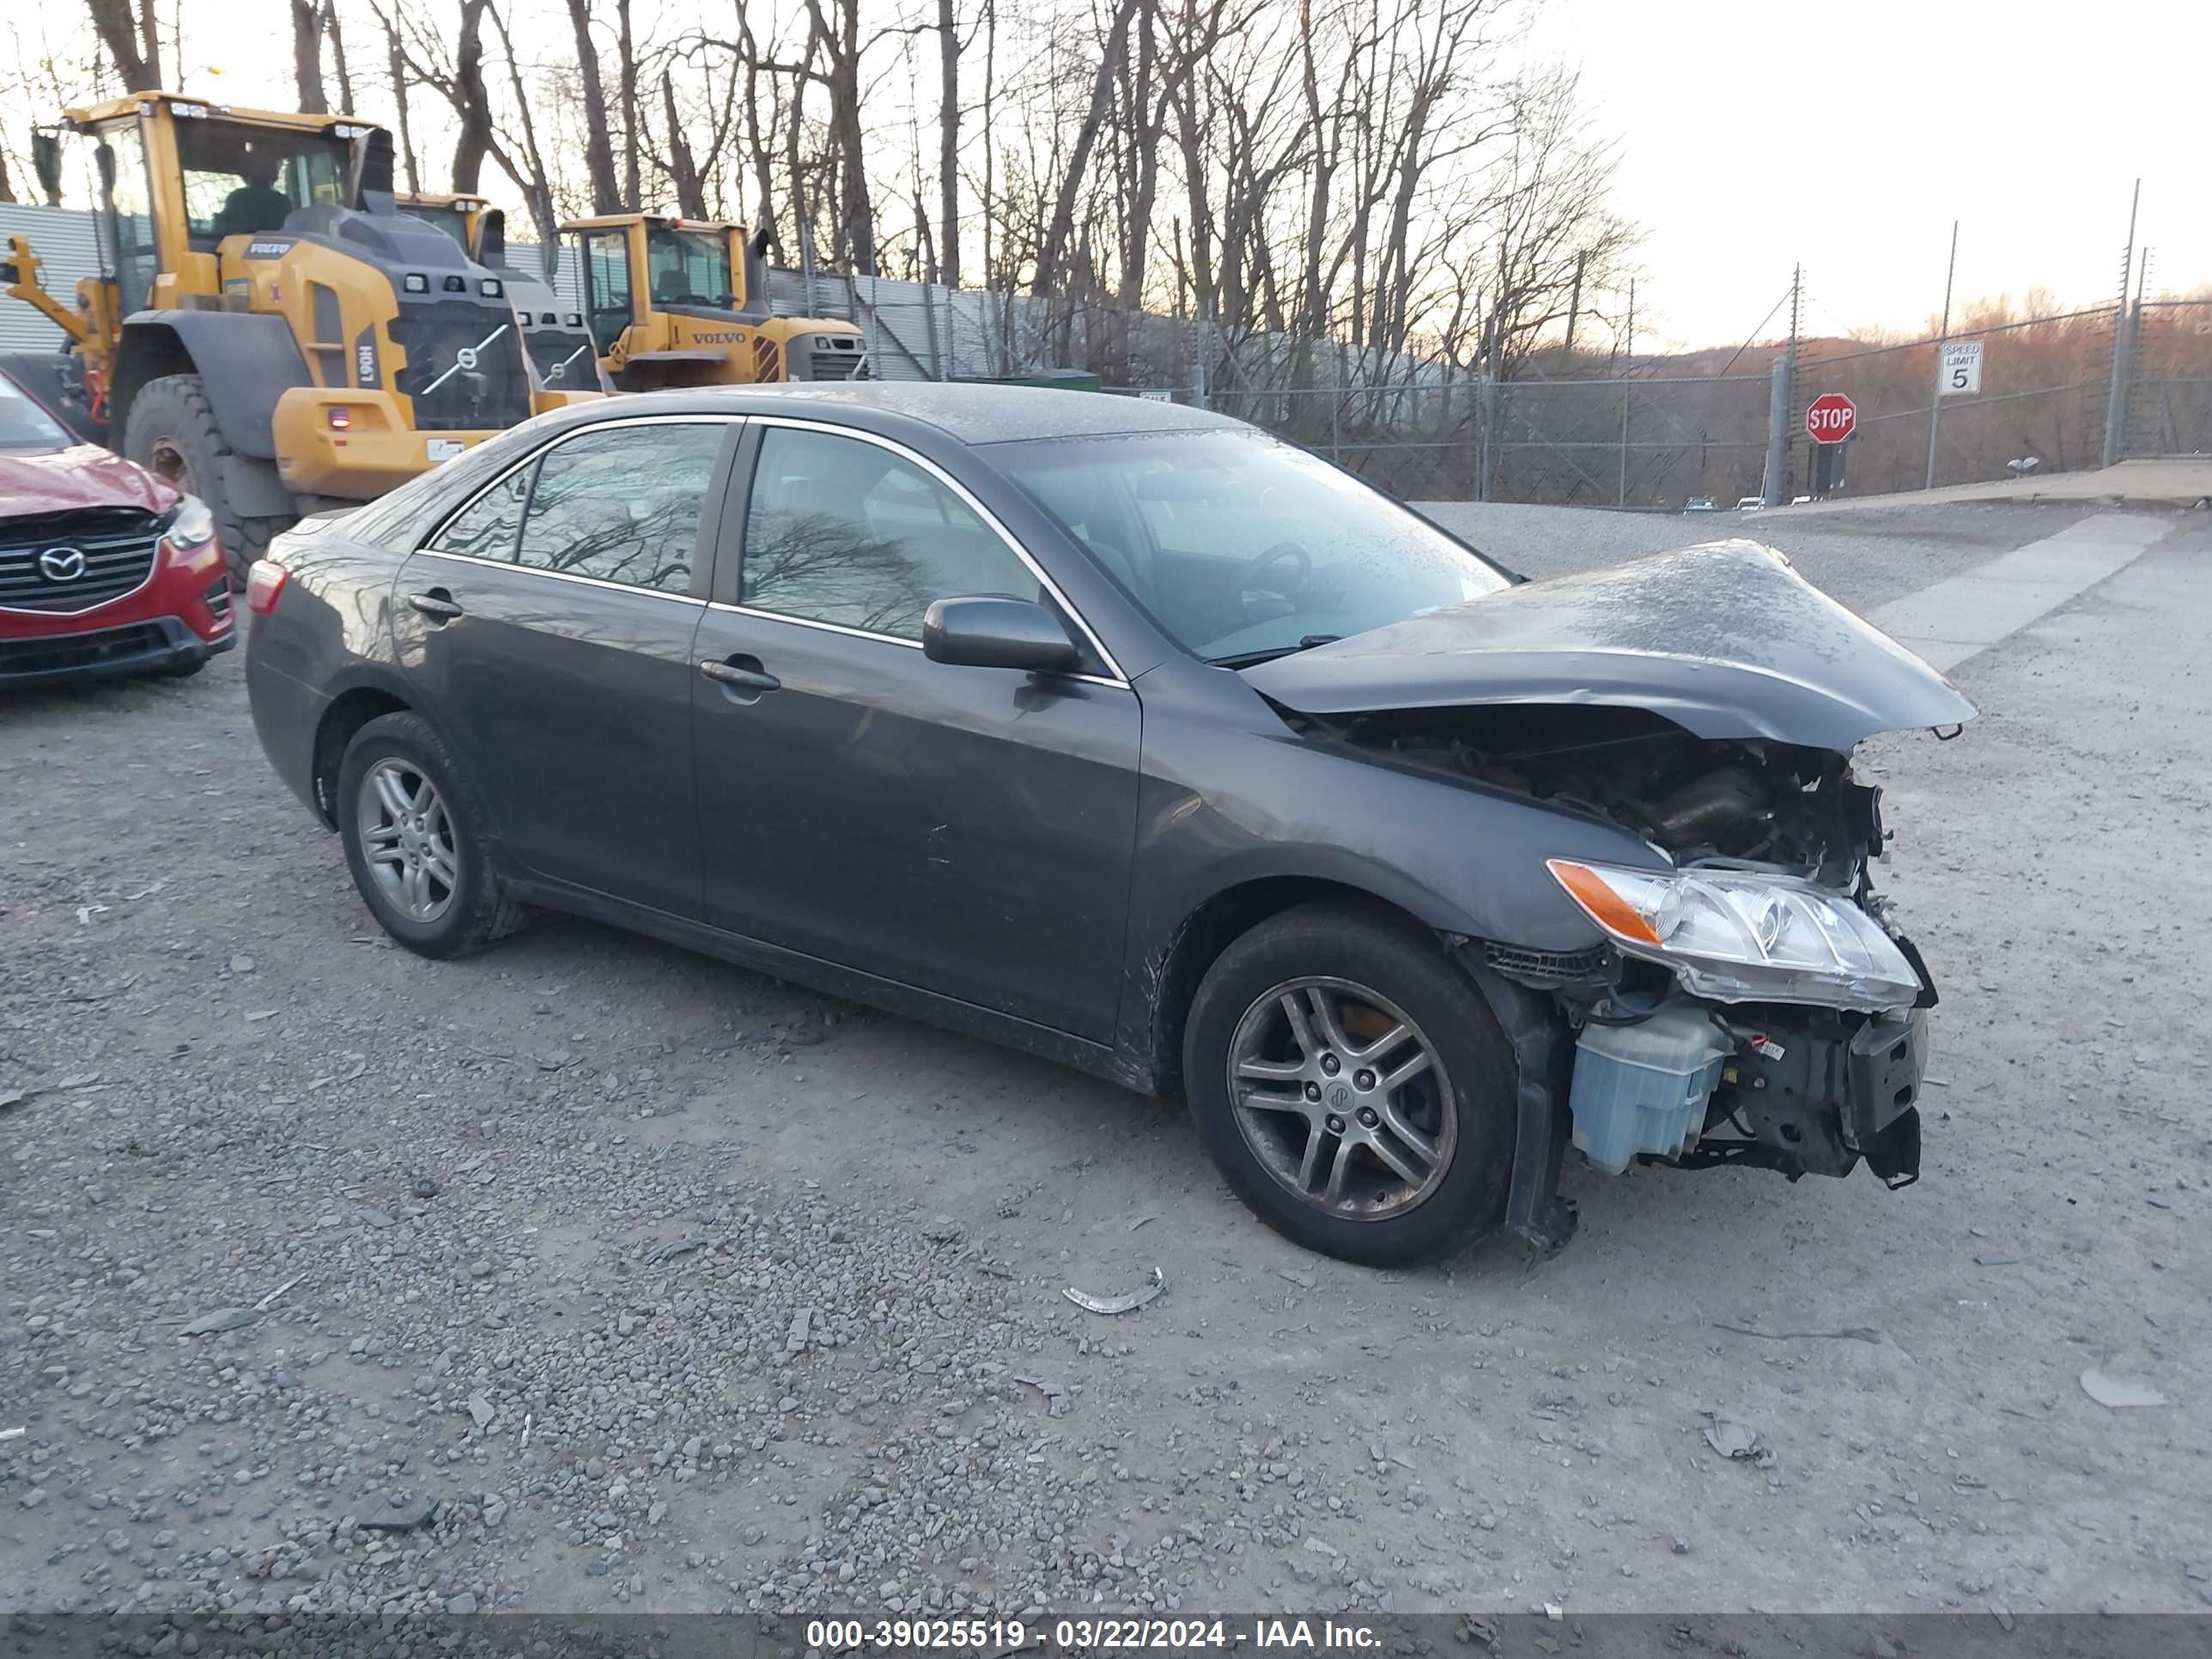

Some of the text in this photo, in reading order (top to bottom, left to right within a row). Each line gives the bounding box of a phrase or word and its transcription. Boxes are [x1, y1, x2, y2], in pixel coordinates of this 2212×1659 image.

[692, 332, 746, 344] VOLVO
[1945, 344, 1980, 356] SPEED
[359, 345, 374, 382] L90H
[1947, 356, 1977, 366] LIMIT
[1952, 368, 1968, 389] 5
[1809, 408, 1853, 430] STOP
